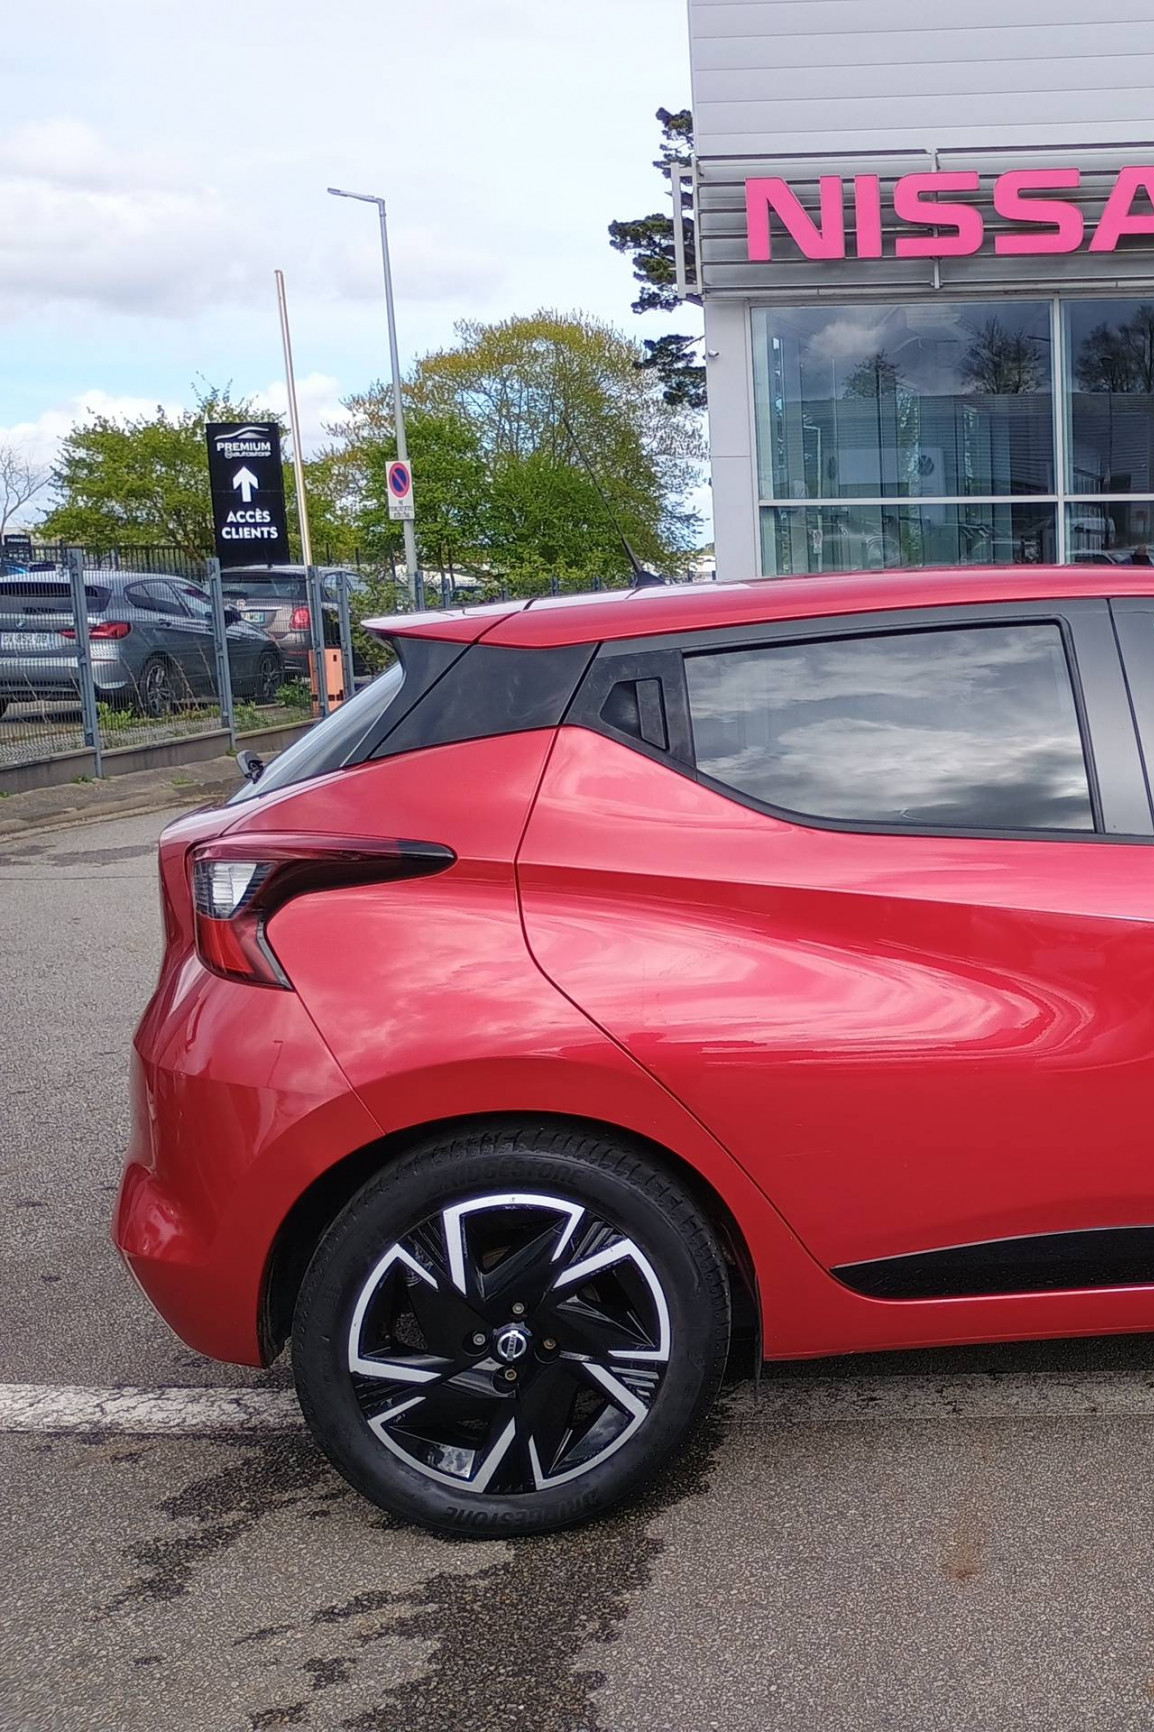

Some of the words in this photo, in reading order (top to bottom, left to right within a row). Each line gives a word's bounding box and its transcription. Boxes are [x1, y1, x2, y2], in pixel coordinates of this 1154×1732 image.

[216, 441, 271, 451] PREMIUM
[226, 508, 271, 523] ACCÈS
[221, 526, 279, 539] CLIENTS
